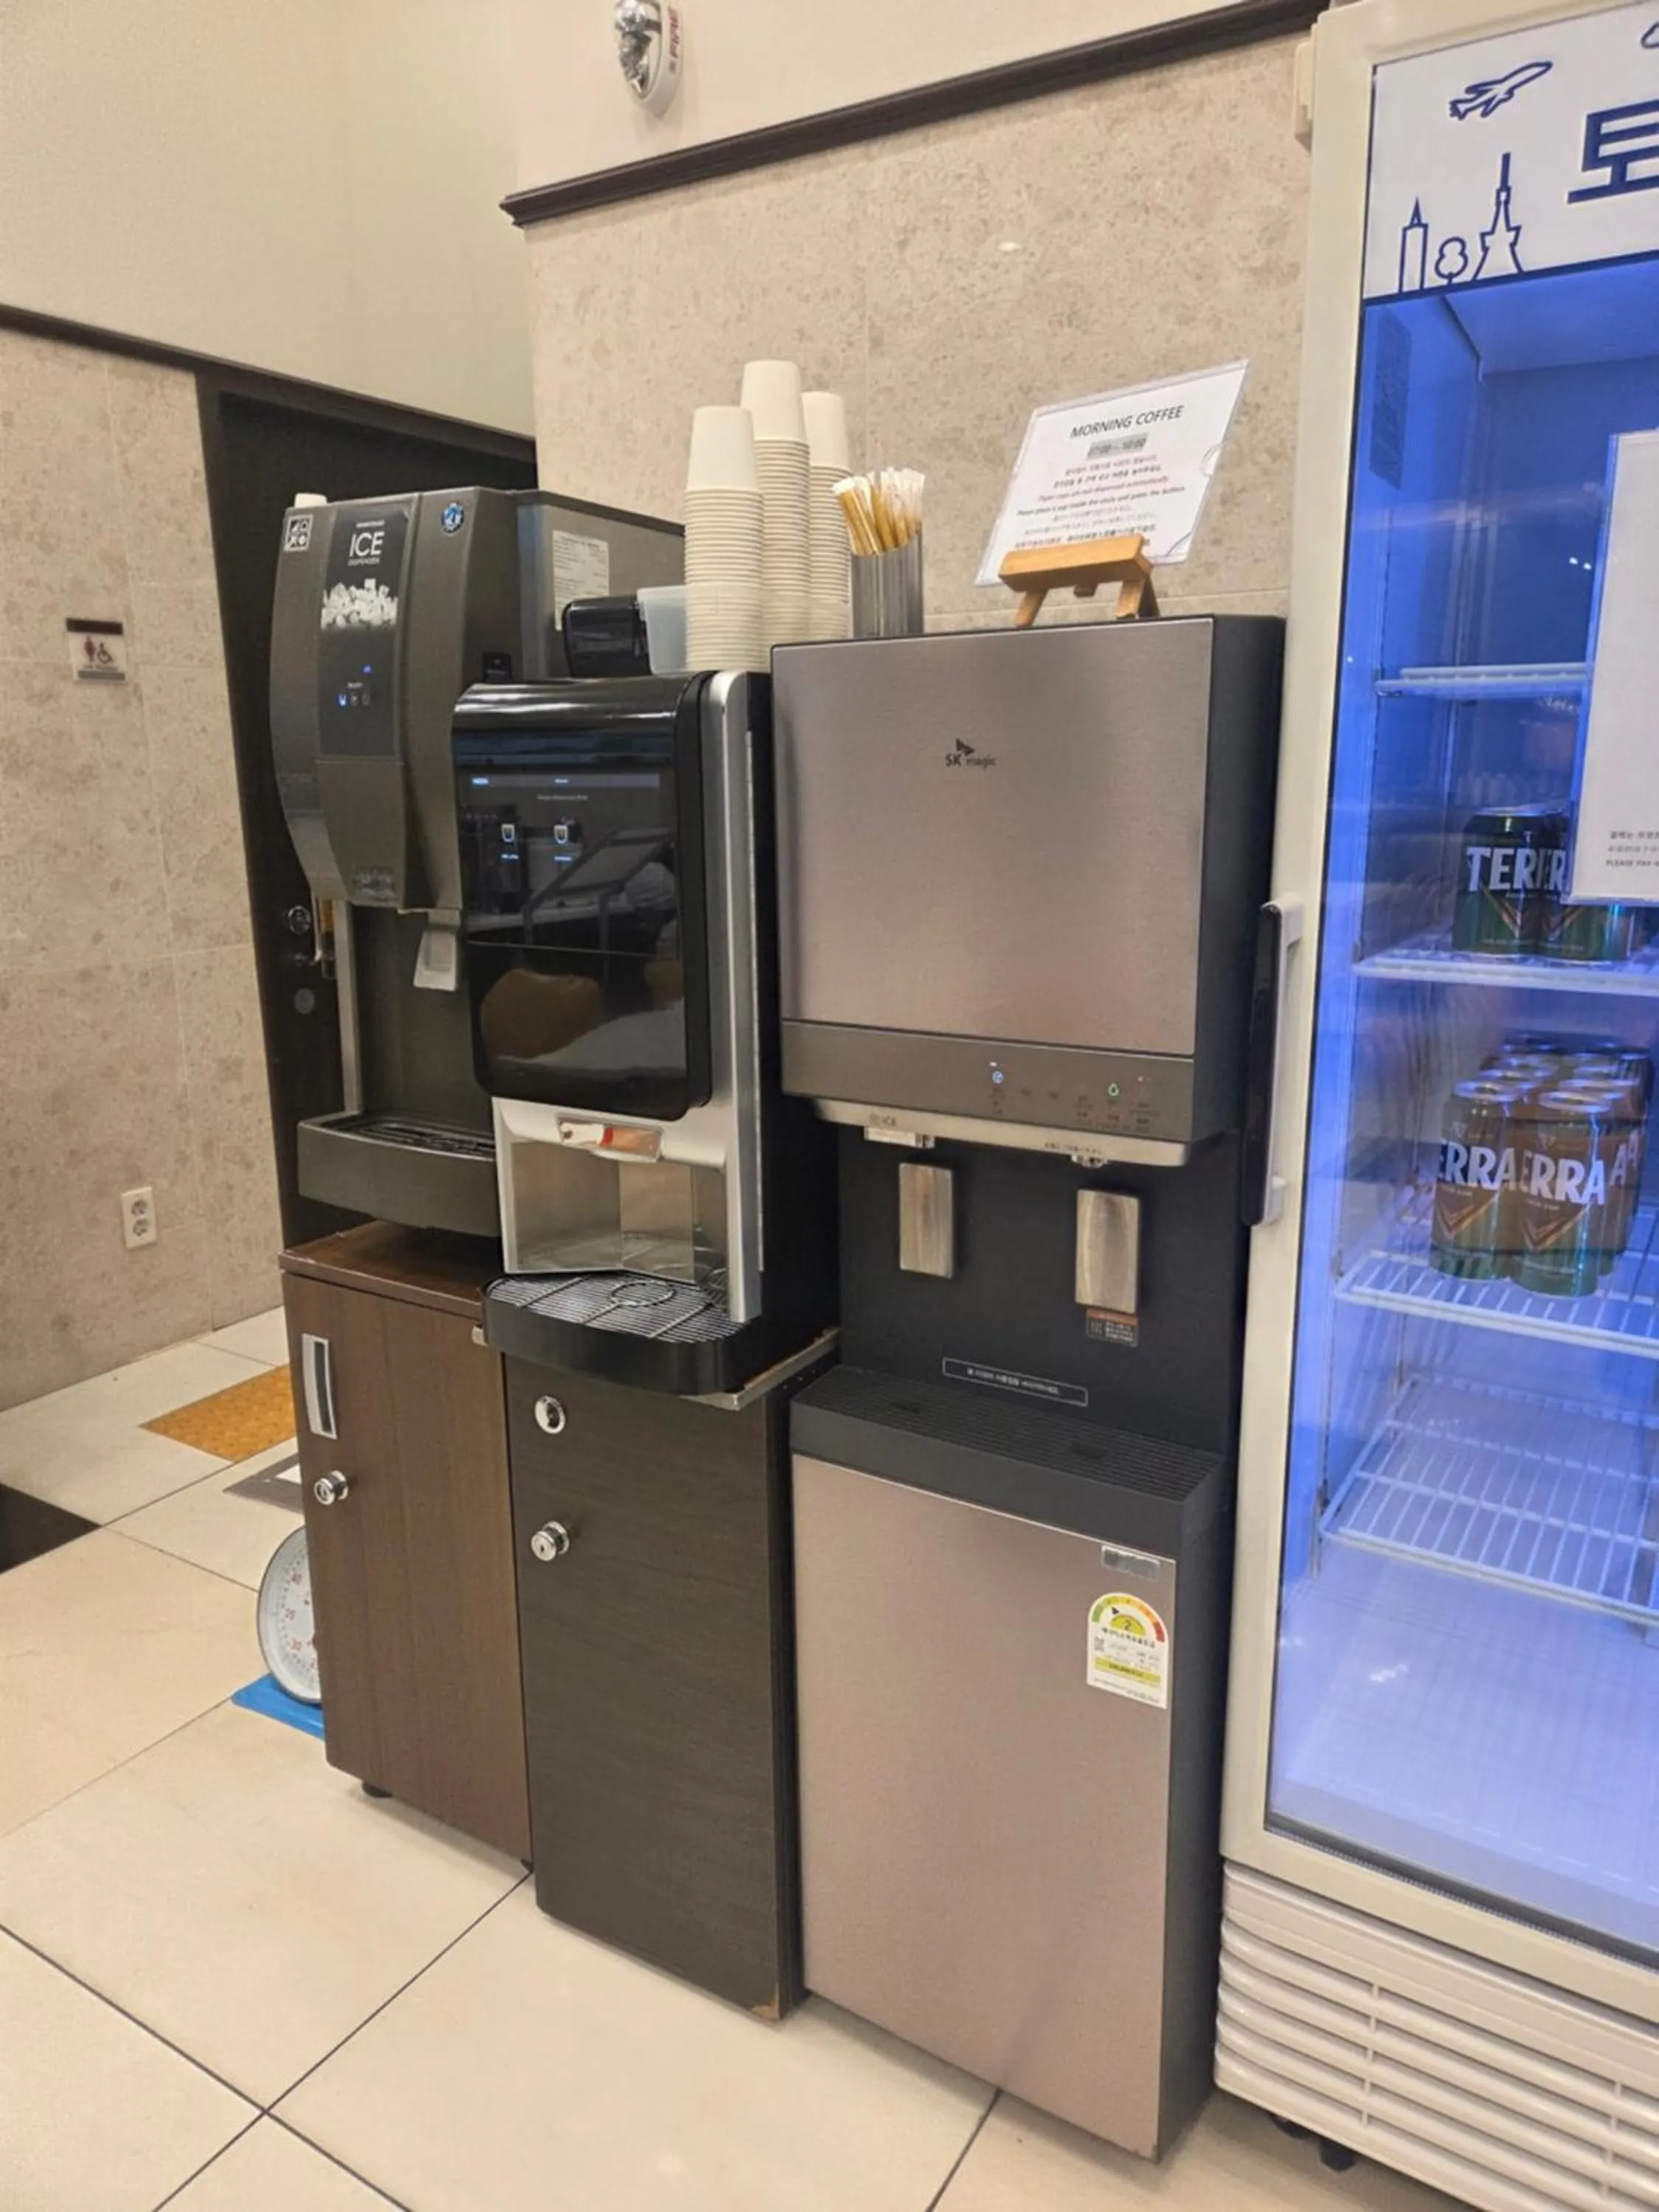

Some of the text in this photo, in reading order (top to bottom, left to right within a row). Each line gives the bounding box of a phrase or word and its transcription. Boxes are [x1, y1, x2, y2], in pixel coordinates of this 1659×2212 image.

[1070, 405, 1185, 438] MORNING COFFEE
[349, 530, 385, 557] ICE
[945, 753, 962, 768] SK
